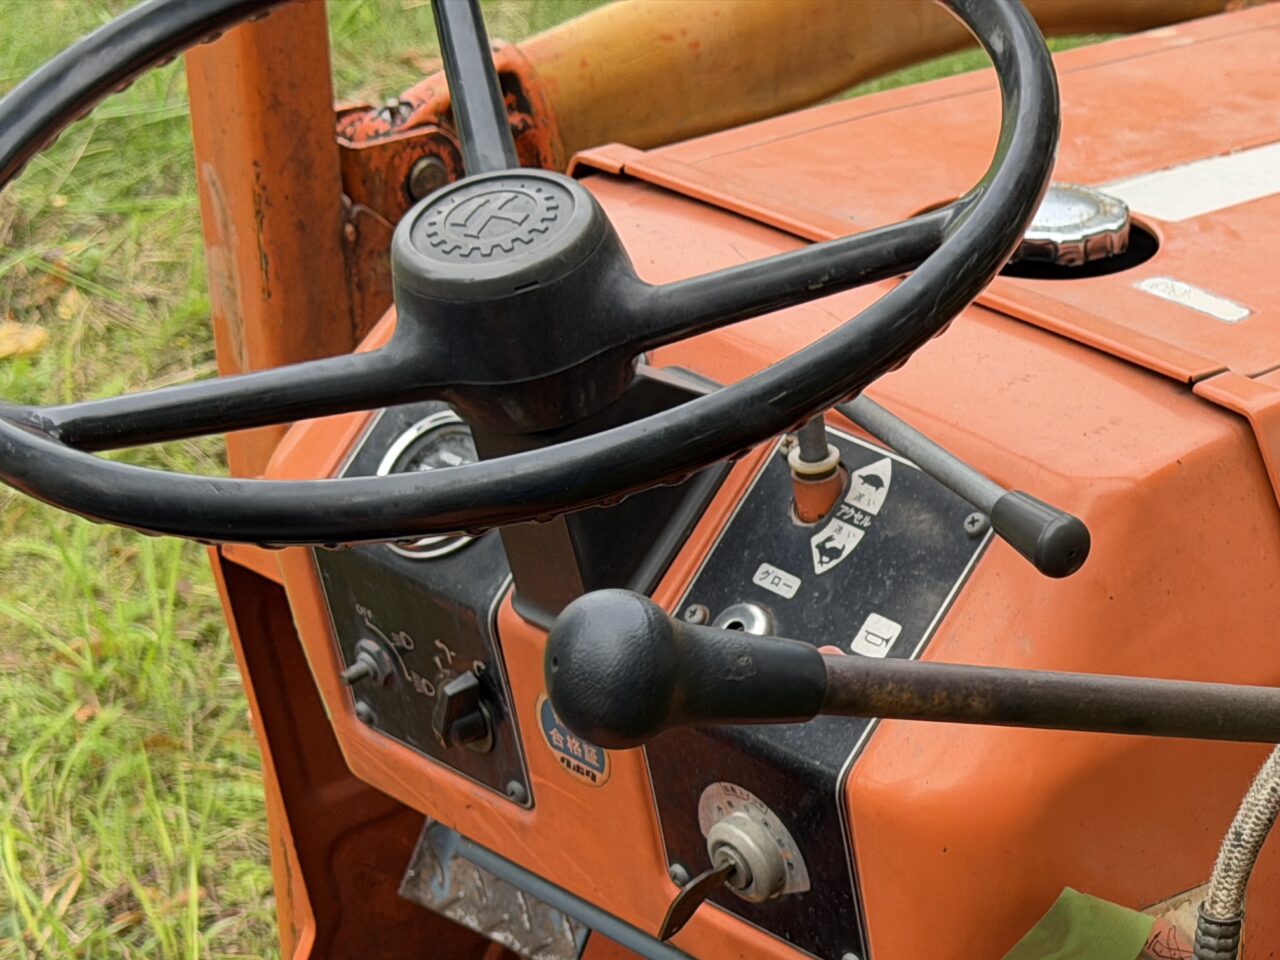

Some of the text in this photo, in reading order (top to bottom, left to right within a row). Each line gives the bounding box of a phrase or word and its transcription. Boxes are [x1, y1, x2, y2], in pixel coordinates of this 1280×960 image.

[836, 504, 871, 527] アクセル
[759, 569, 793, 589] グロー
